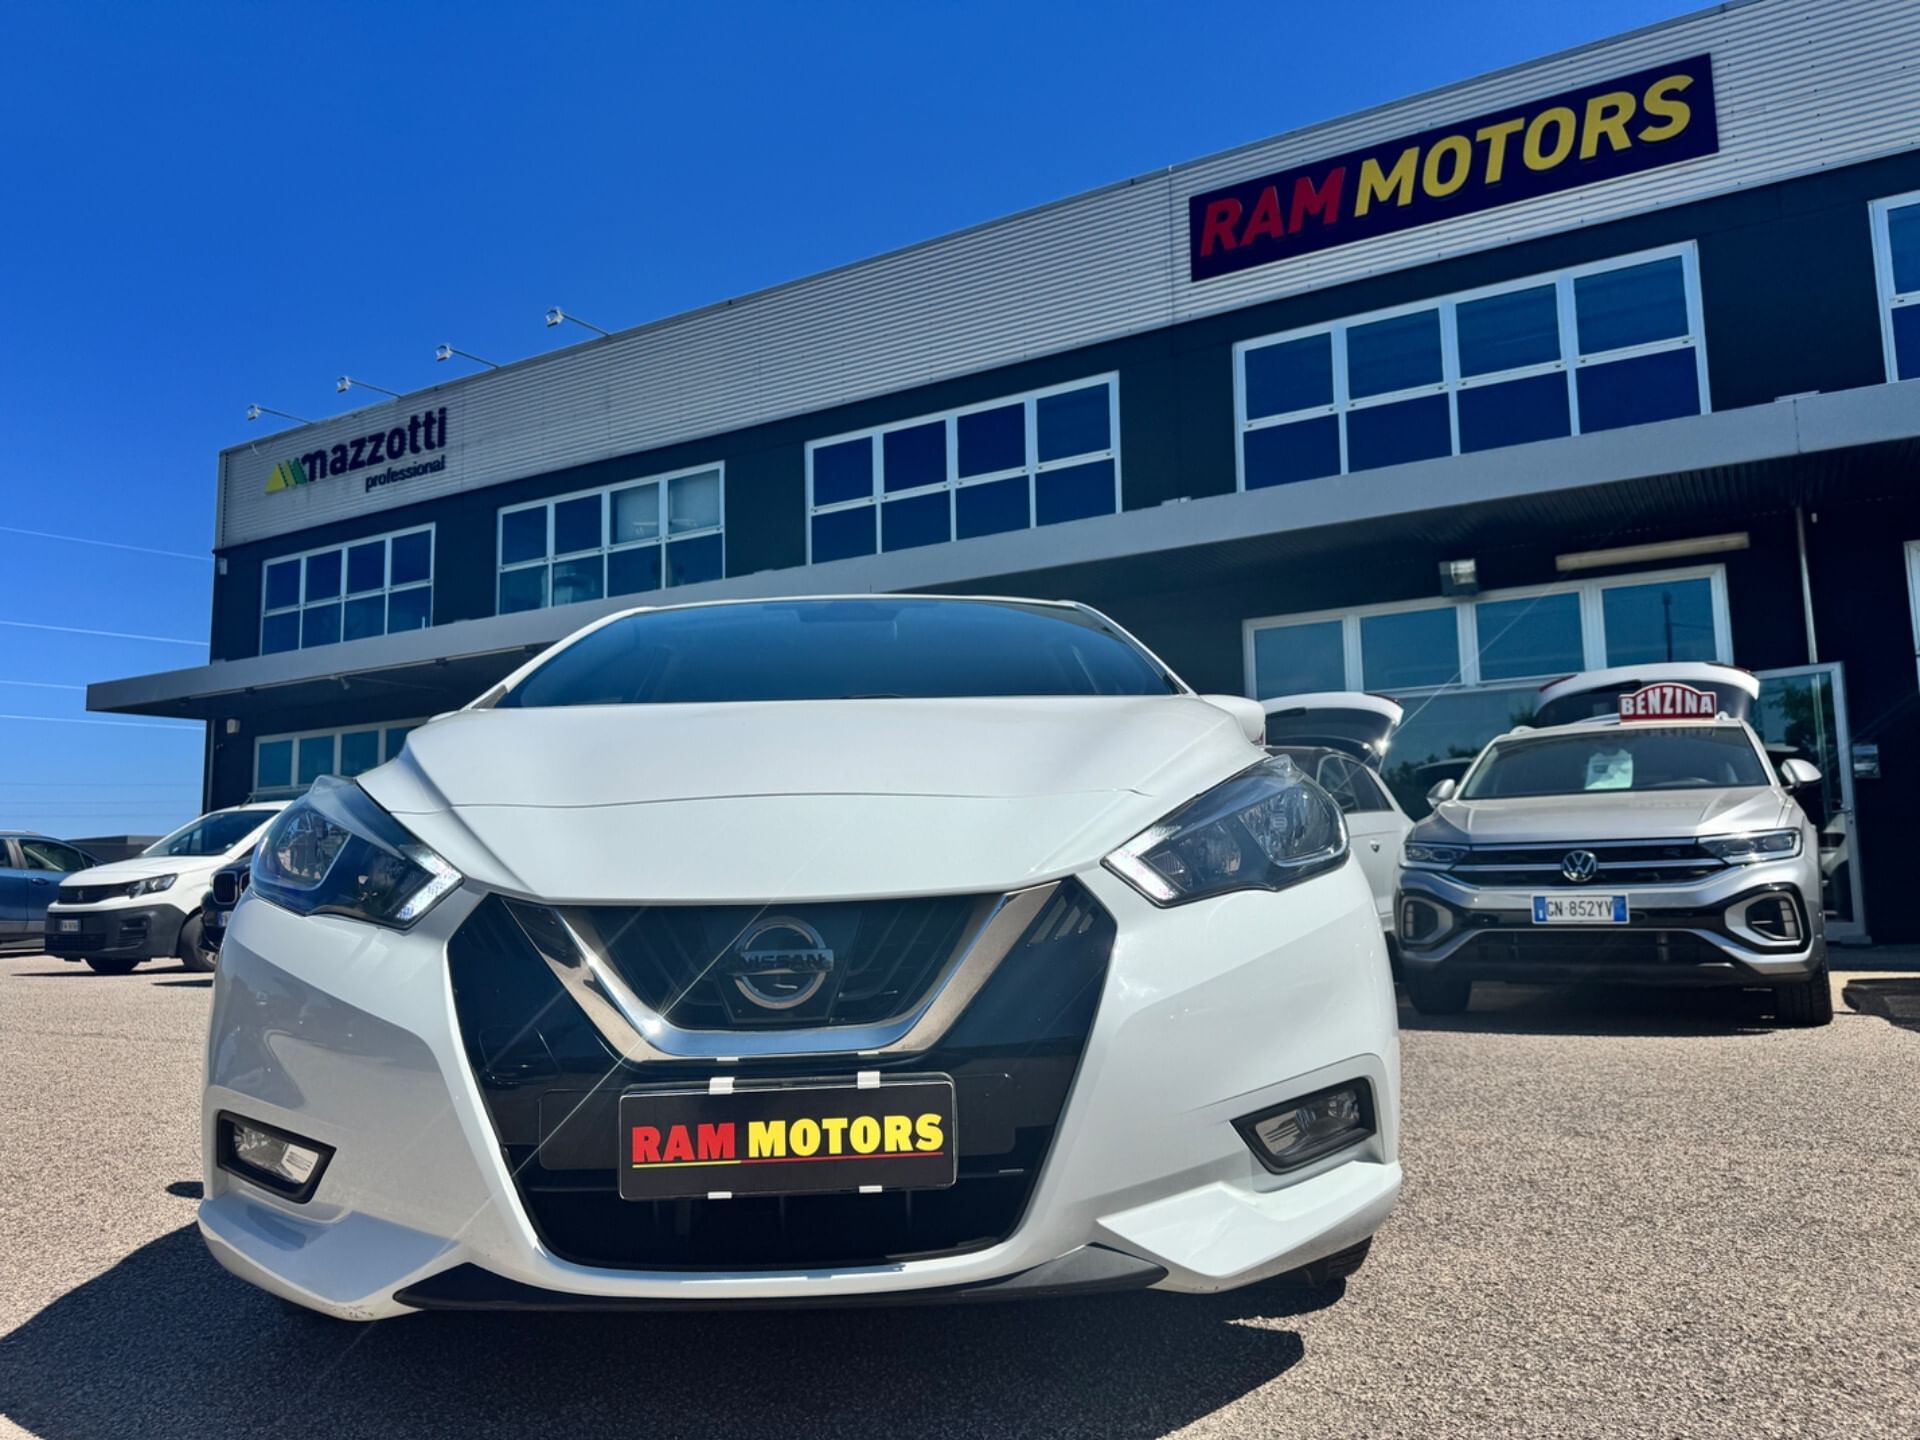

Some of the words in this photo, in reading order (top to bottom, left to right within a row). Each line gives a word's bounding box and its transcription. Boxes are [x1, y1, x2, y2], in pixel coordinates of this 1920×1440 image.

[1200, 166, 1346, 257] RAM
[1354, 73, 1695, 218] MOTORS
[301, 406, 447, 483] mazzotti
[365, 454, 446, 493] professional
[1620, 686, 1714, 716] BENZINA
[742, 952, 828, 971] NISSAN
[631, 1122, 736, 1163] RAM
[748, 1112, 945, 1158] MOTORS
